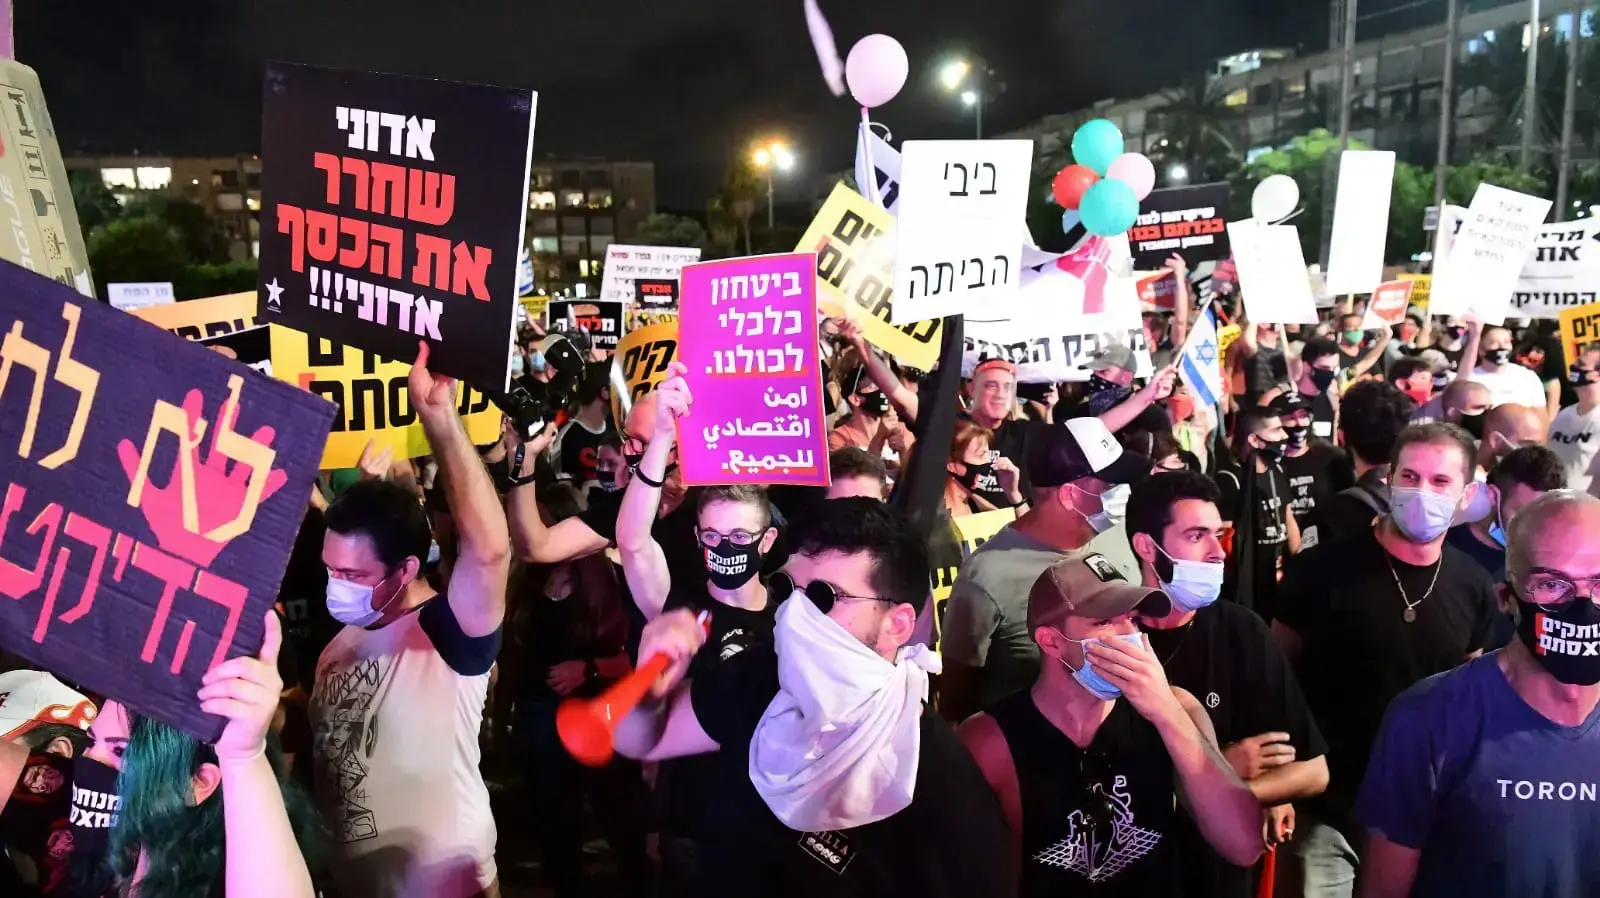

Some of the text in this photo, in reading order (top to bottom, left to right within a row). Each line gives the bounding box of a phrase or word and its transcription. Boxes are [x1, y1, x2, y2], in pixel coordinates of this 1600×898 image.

[335, 106, 436, 161] אדוני
[314, 152, 455, 226] שחרר
[944, 162, 997, 196] ביבי
[277, 203, 492, 302] את הכסף
[1535, 246, 1582, 262] את
[710, 271, 802, 305] ביטחון
[909, 255, 1009, 299] הביתה
[308, 266, 444, 342] אדוני!!!
[1510, 291, 1597, 308] המוזיק
[718, 304, 802, 336] כלכלי
[705, 341, 804, 374] לכולנו.
[763, 384, 808, 408] امن
[702, 413, 811, 450] اقتصادي
[721, 450, 814, 475] للجميع.
[707, 549, 748, 565] מנותקים
[0, 482, 250, 676] הדיקט
[1542, 616, 1600, 639] ותקים
[1539, 633, 1600, 656] אסתם
[806, 836, 841, 864] BONG
